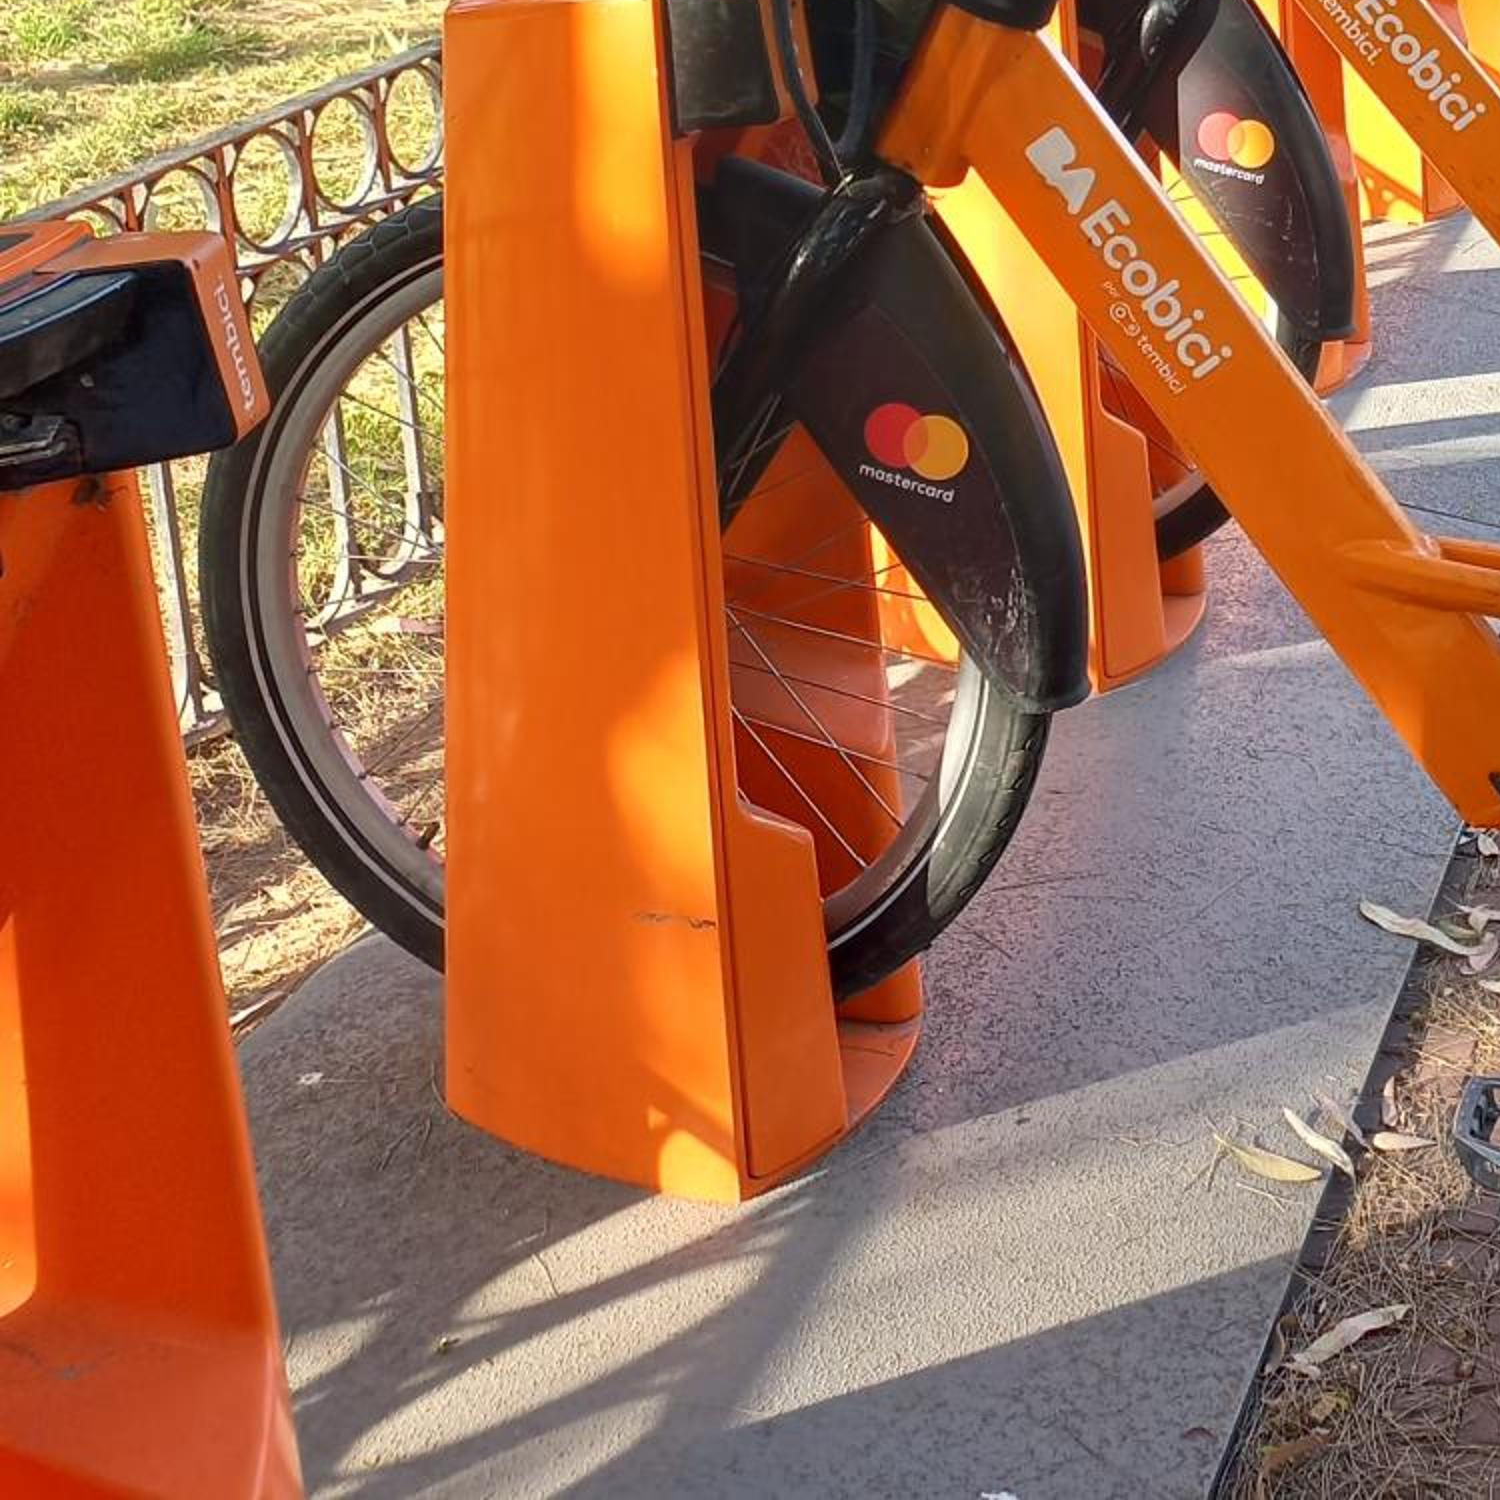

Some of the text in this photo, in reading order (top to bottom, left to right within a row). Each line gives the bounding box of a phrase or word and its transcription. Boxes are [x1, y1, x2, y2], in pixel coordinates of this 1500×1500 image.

[1193, 157, 1264, 185] mastercard
[1080, 199, 1232, 379] Ecobici
[213, 275, 256, 412] tembici
[1135, 335, 1185, 394] tembici
[859, 463, 955, 503] mastercard
